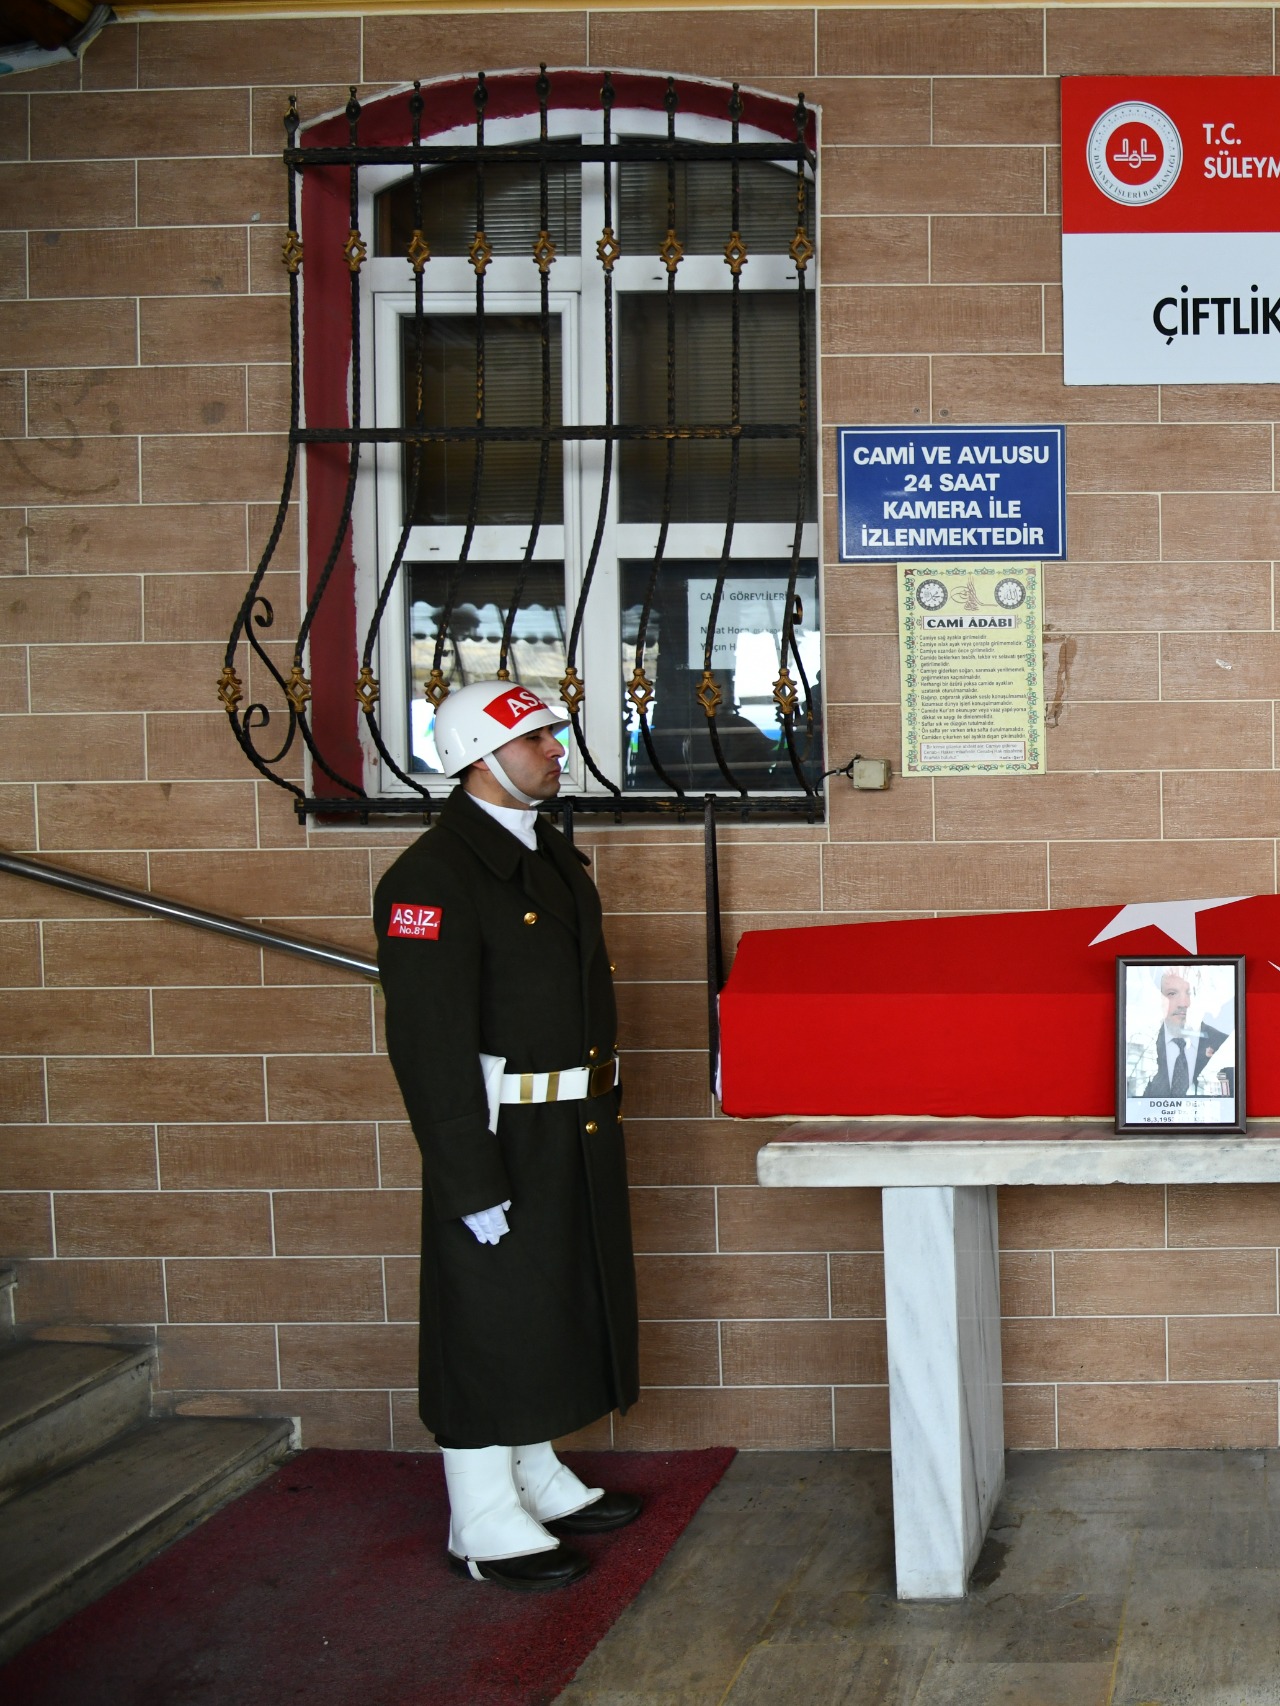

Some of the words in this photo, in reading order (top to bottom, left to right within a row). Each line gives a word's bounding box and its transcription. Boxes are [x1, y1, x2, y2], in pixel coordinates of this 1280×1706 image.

[1203, 123, 1241, 145] T.C.
[1094, 155, 1115, 189] DİYANET
[853, 442, 915, 465] CAMİ
[922, 446, 951, 464] VE
[957, 446, 1050, 465] AVLUSU
[904, 474, 932, 491] 24
[939, 473, 1000, 491] SAAT
[883, 500, 982, 519] KAMERA
[989, 496, 1022, 518] İLE
[861, 523, 1044, 546] İZLENMEKTEDİR
[700, 591, 724, 600] CAİ
[730, 591, 788, 600] GÖREVLİLER
[927, 616, 964, 628] CAMİ
[968, 616, 1012, 628] ÂDÂBI
[392, 908, 438, 928] AS.İZ.
[400, 925, 426, 936] No.81
